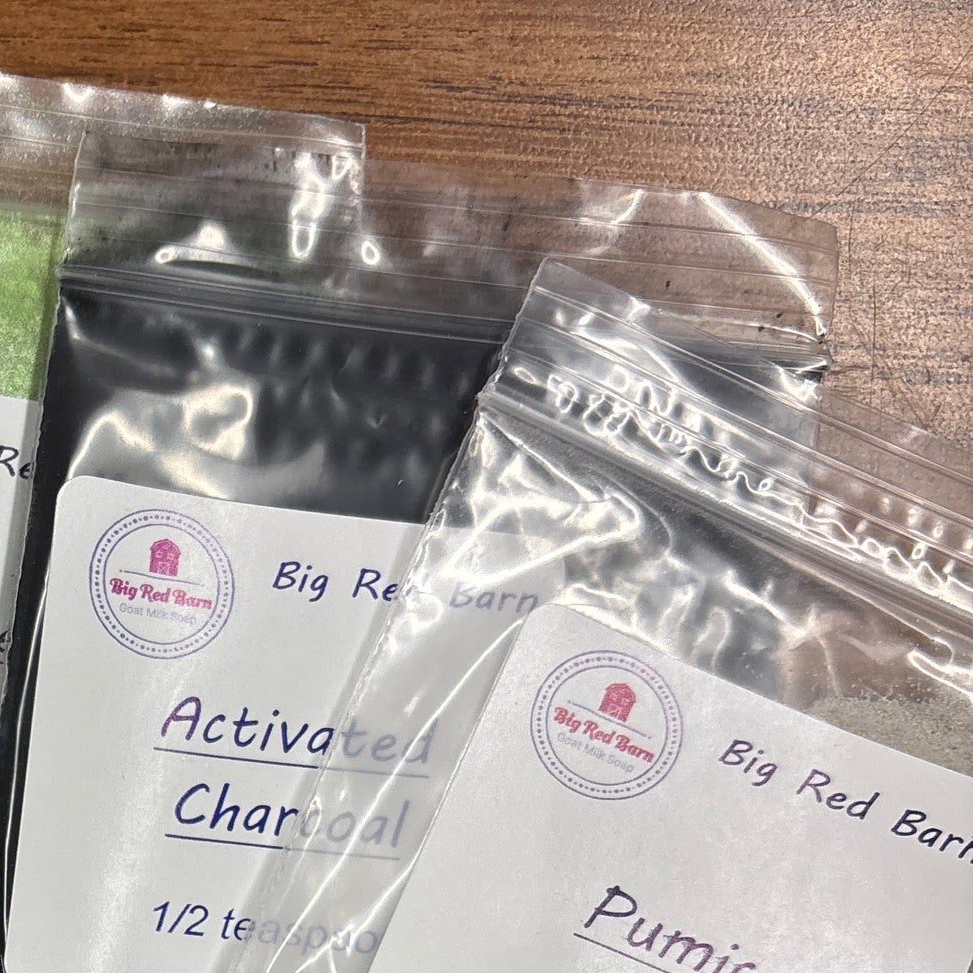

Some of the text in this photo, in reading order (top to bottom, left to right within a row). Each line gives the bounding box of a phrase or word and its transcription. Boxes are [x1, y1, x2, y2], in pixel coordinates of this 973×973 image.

[109, 578, 213, 610] Big Red Barn
[272, 561, 539, 613] Big Re Barn
[119, 602, 143, 616] Goat
[171, 612, 197, 625] Soap
[160, 696, 438, 765] Activated
[553, 706, 655, 763] Big Red Barn
[556, 732, 634, 773] Goat Milk Soap
[718, 739, 777, 787] Big
[796, 769, 880, 820] Red
[174, 782, 410, 848] Charcoal
[153, 900, 210, 938] 1/2
